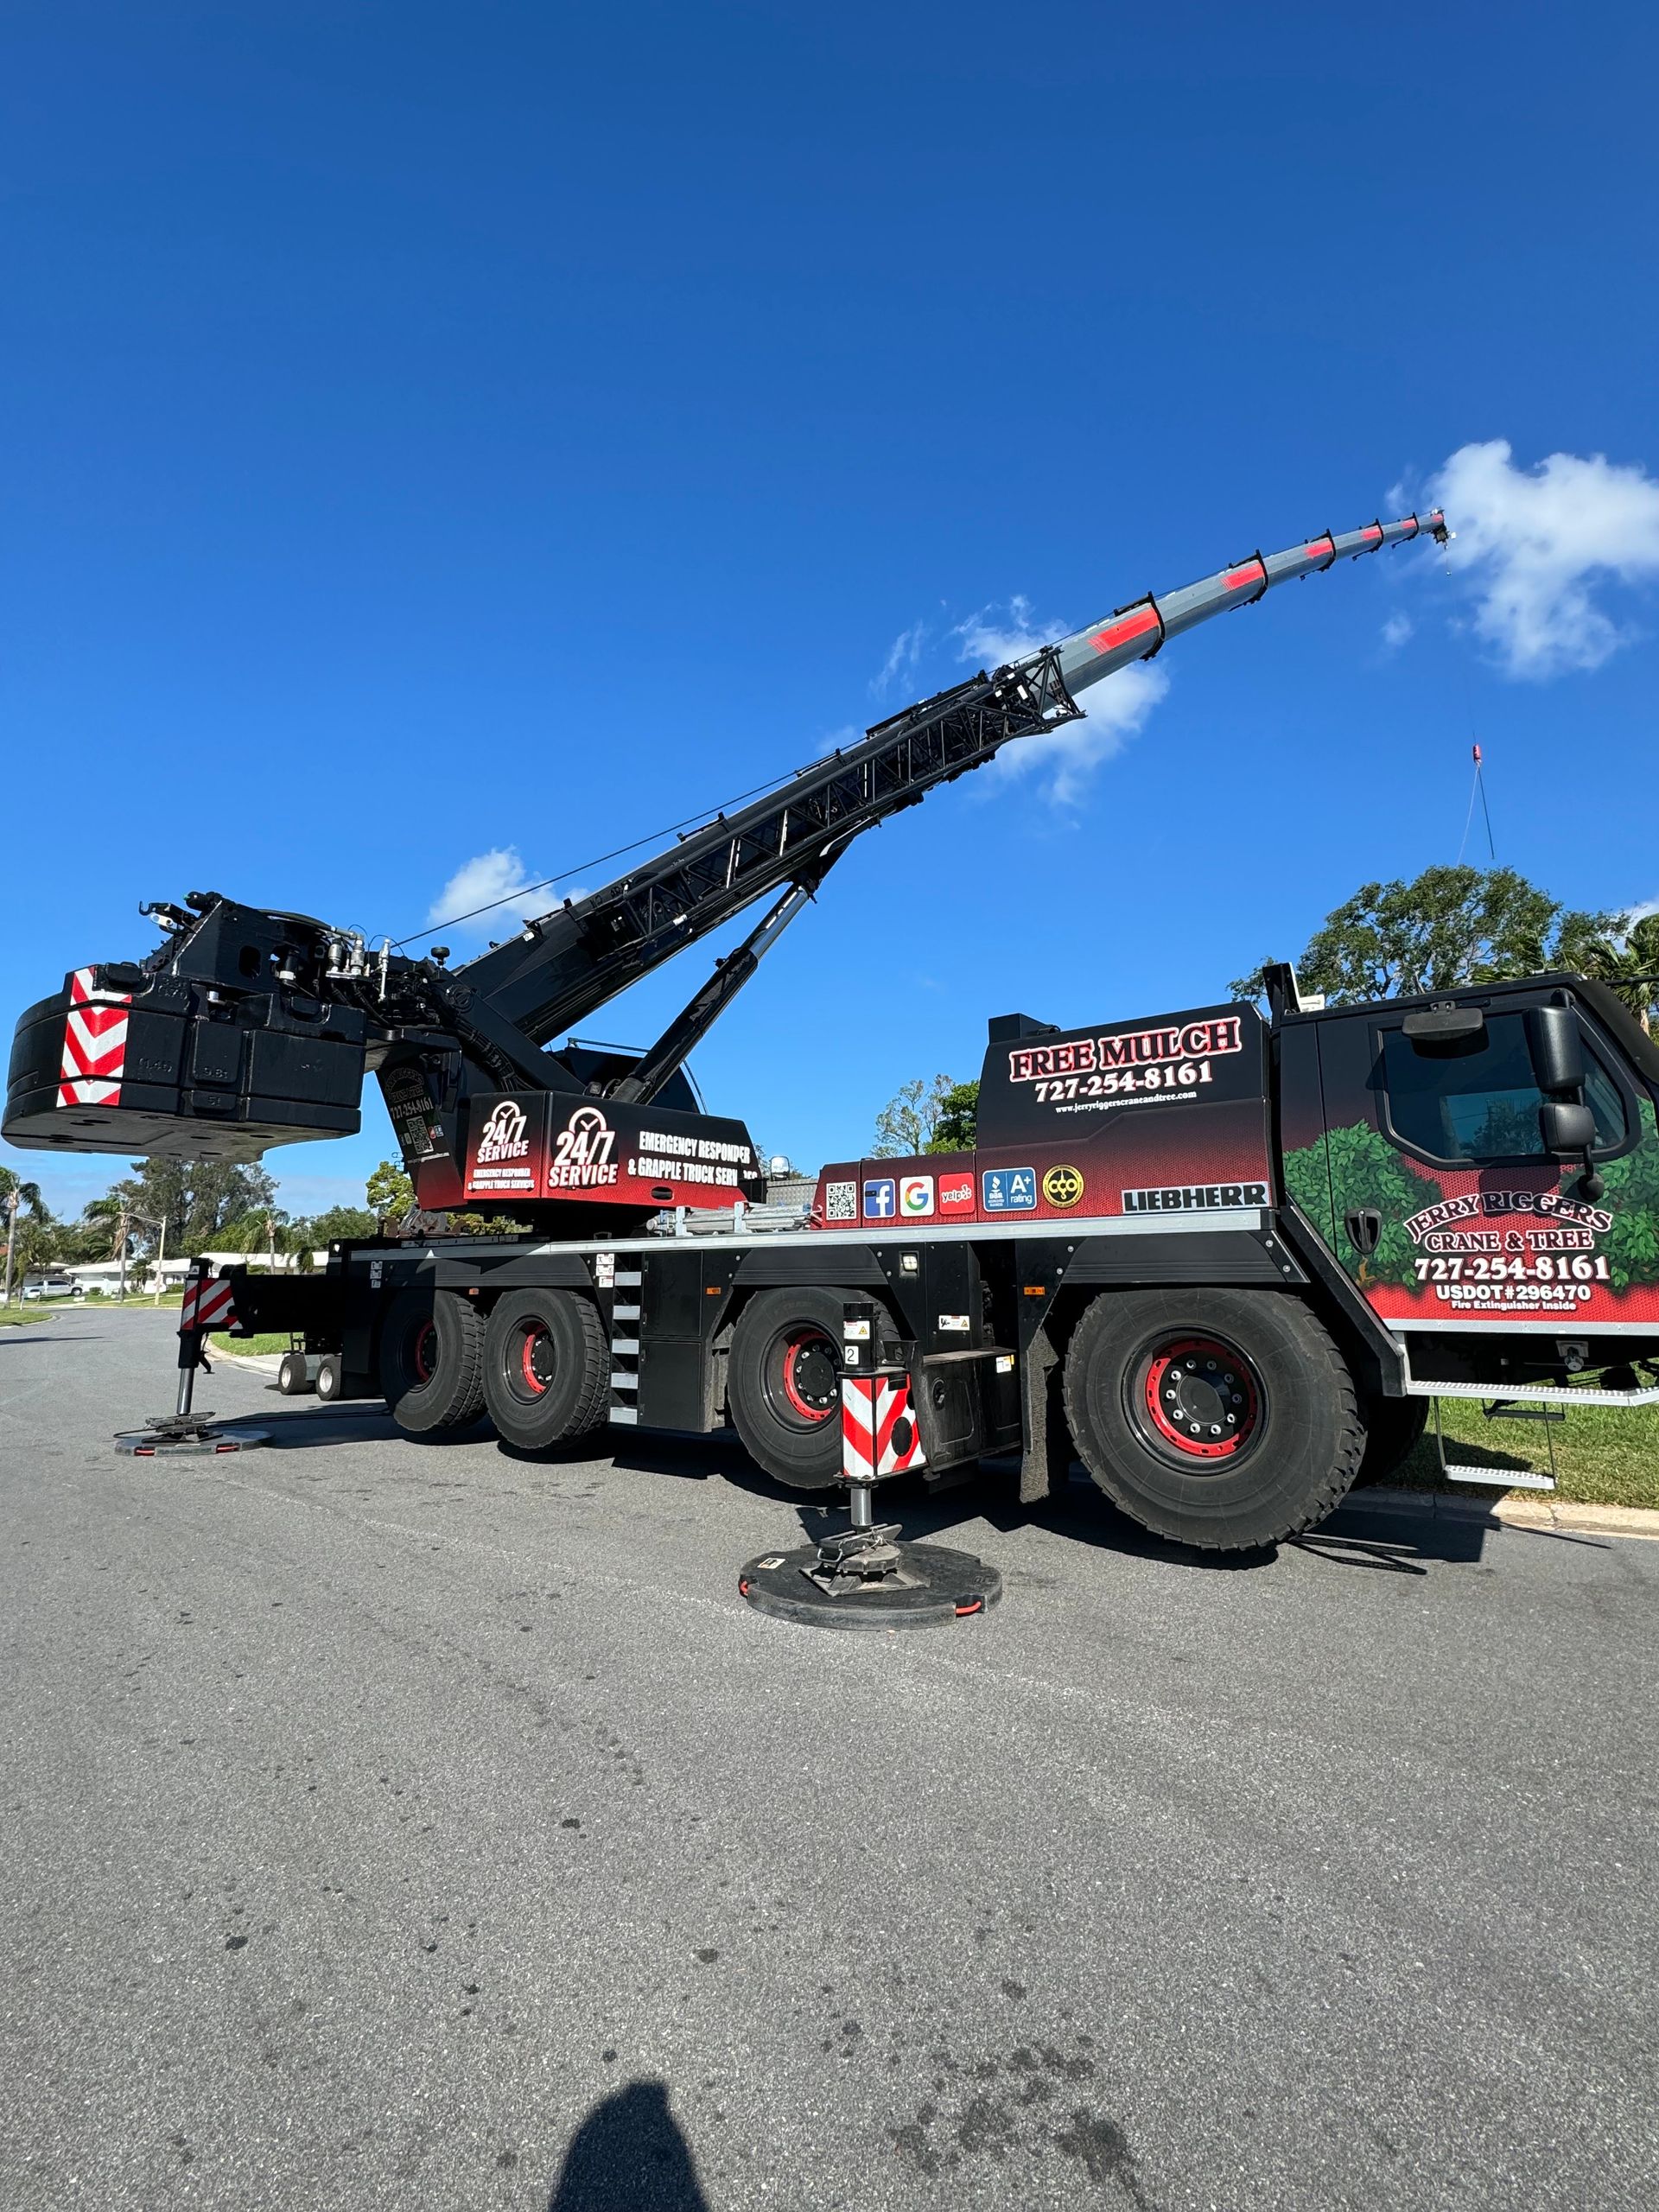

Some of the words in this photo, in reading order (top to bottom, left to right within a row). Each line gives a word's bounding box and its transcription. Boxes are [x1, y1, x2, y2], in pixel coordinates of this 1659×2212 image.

[1010, 1039, 1096, 1083] FREE
[1098, 1016, 1242, 1071] MULCH
[1035, 1060, 1213, 1103] 727-254-8161
[1056, 1090, 1197, 1113] www.jerryriggerscraneandtree.com
[481, 1116, 527, 1148] 24/7
[477, 1140, 530, 1164] SERVICE
[554, 1131, 616, 1166] 24/7
[639, 1130, 697, 1157] EMERGENCY
[698, 1140, 751, 1164] RESPONDER
[549, 1164, 619, 1187] SERVICE
[628, 1159, 637, 1176] &
[638, 1157, 682, 1181] GRAPPLE
[683, 1162, 715, 1185] TRUCK
[1010, 1174, 1032, 1193] A+
[942, 1189, 962, 1203] yelp
[1010, 1193, 1033, 1205] rating
[1123, 1185, 1267, 1211] LIEBHERR
[1403, 1193, 1480, 1243] JERRY
[1481, 1191, 1613, 1232] RIGGERS
[1425, 1231, 1502, 1253] CRANE
[1505, 1230, 1524, 1251] &
[1526, 1229, 1594, 1251] TREE
[1414, 1255, 1611, 1281] 727-254-8161
[1452, 1300, 1471, 1309] Fire
[1474, 1300, 1540, 1311] Extinguisher
[1542, 1300, 1576, 1310] Inside
[847, 1348, 855, 1362] 2
